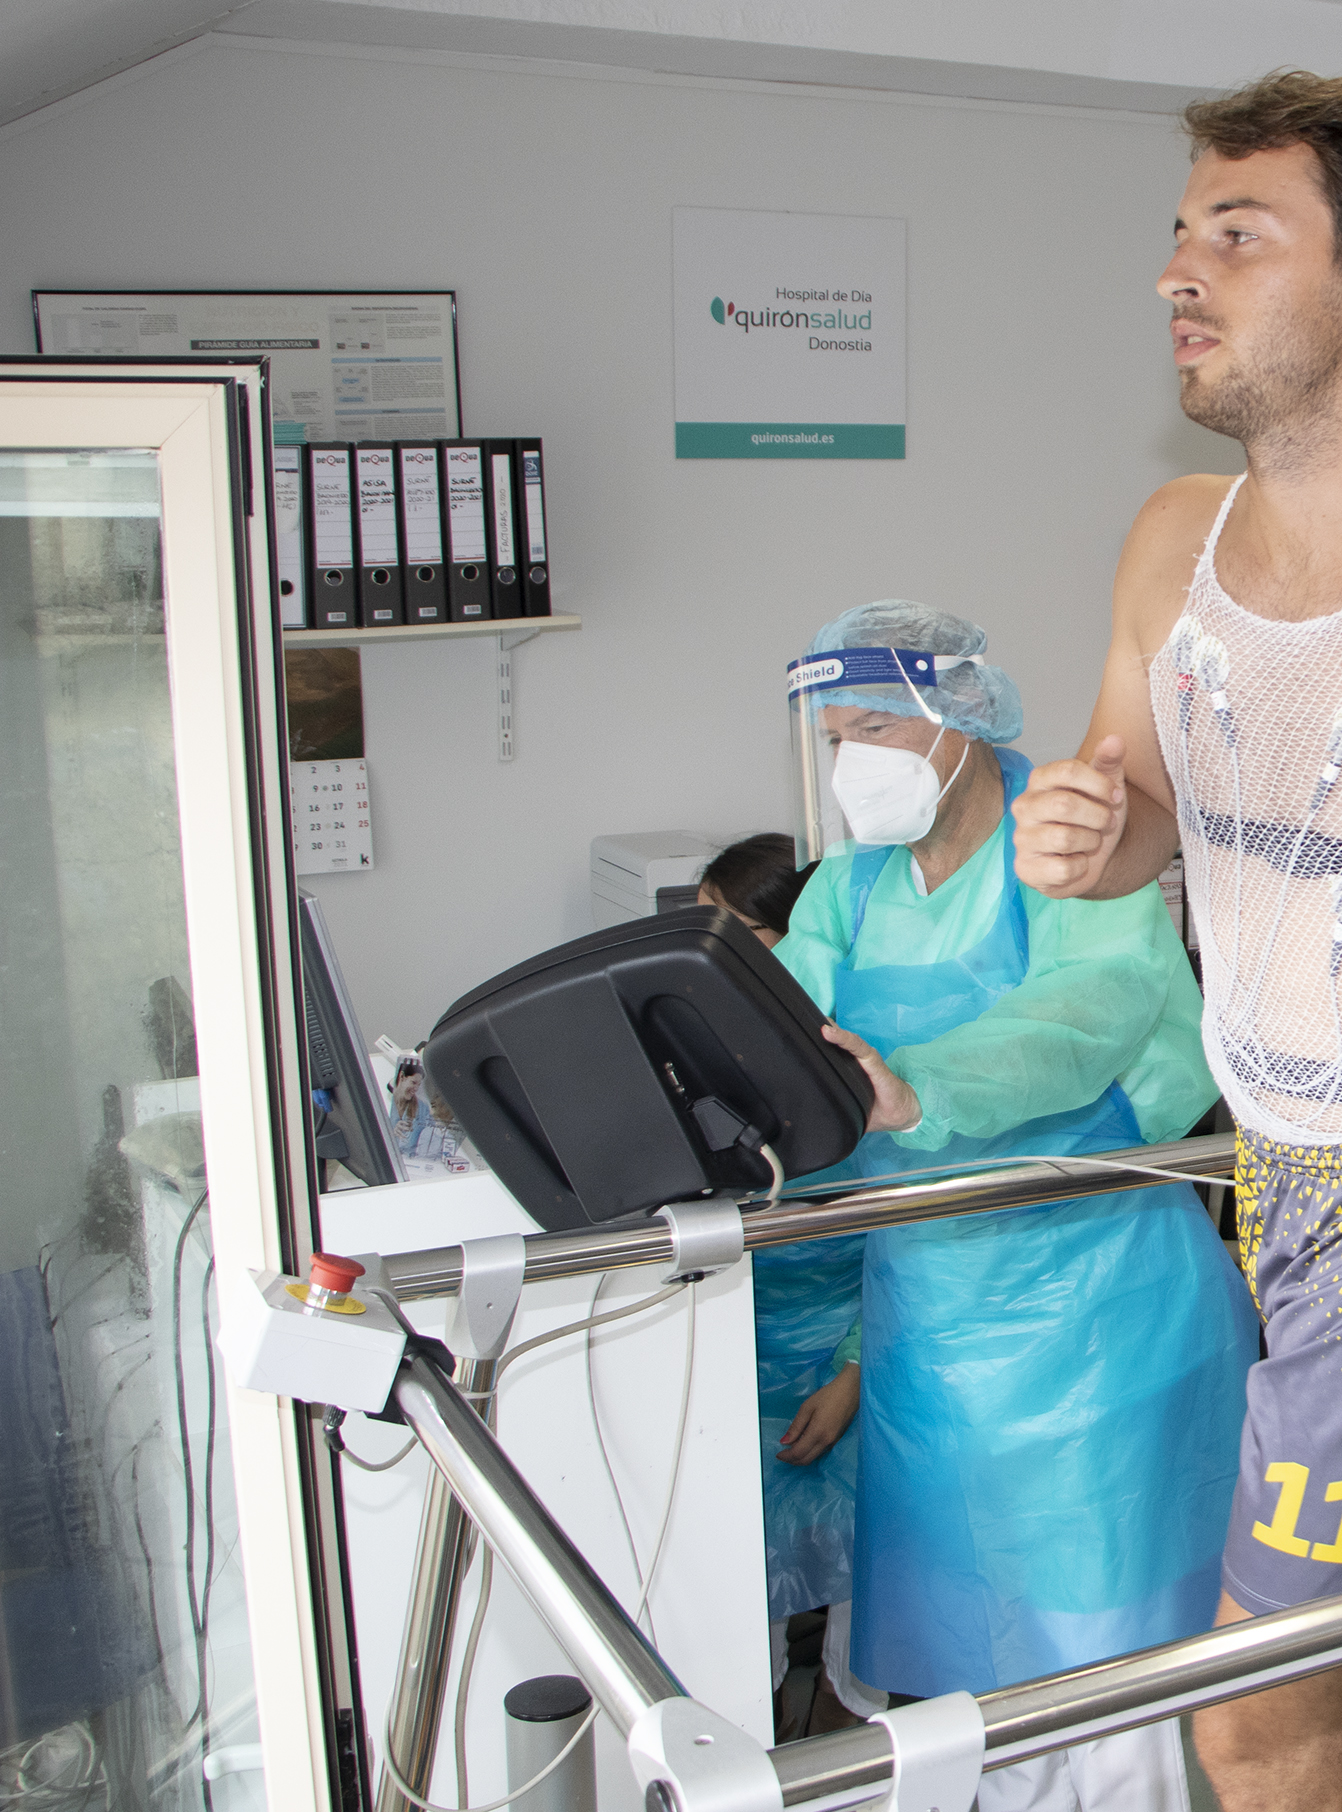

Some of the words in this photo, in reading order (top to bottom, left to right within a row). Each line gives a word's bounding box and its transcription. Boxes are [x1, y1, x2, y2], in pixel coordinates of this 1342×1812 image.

[776, 287, 829, 302] Hospital
[832, 290, 848, 301] de
[851, 289, 872, 302] Día
[735, 307, 871, 333] quirónsalud
[260, 340, 313, 348] ALIMENTARIA
[809, 336, 872, 351] Donostia
[751, 432, 834, 445] quironsalud.es
[796, 664, 835, 683] Shield
[331, 783, 343, 792] 10
[355, 782, 367, 790] 11
[309, 804, 320, 812] 16
[332, 802, 344, 811] 17
[357, 801, 368, 809] 18
[310, 823, 321, 831] 23
[334, 821, 346, 830] 24
[358, 820, 369, 828] 25
[311, 842, 323, 850] 30
[335, 840, 346, 848] 31
[359, 853, 370, 865] k
